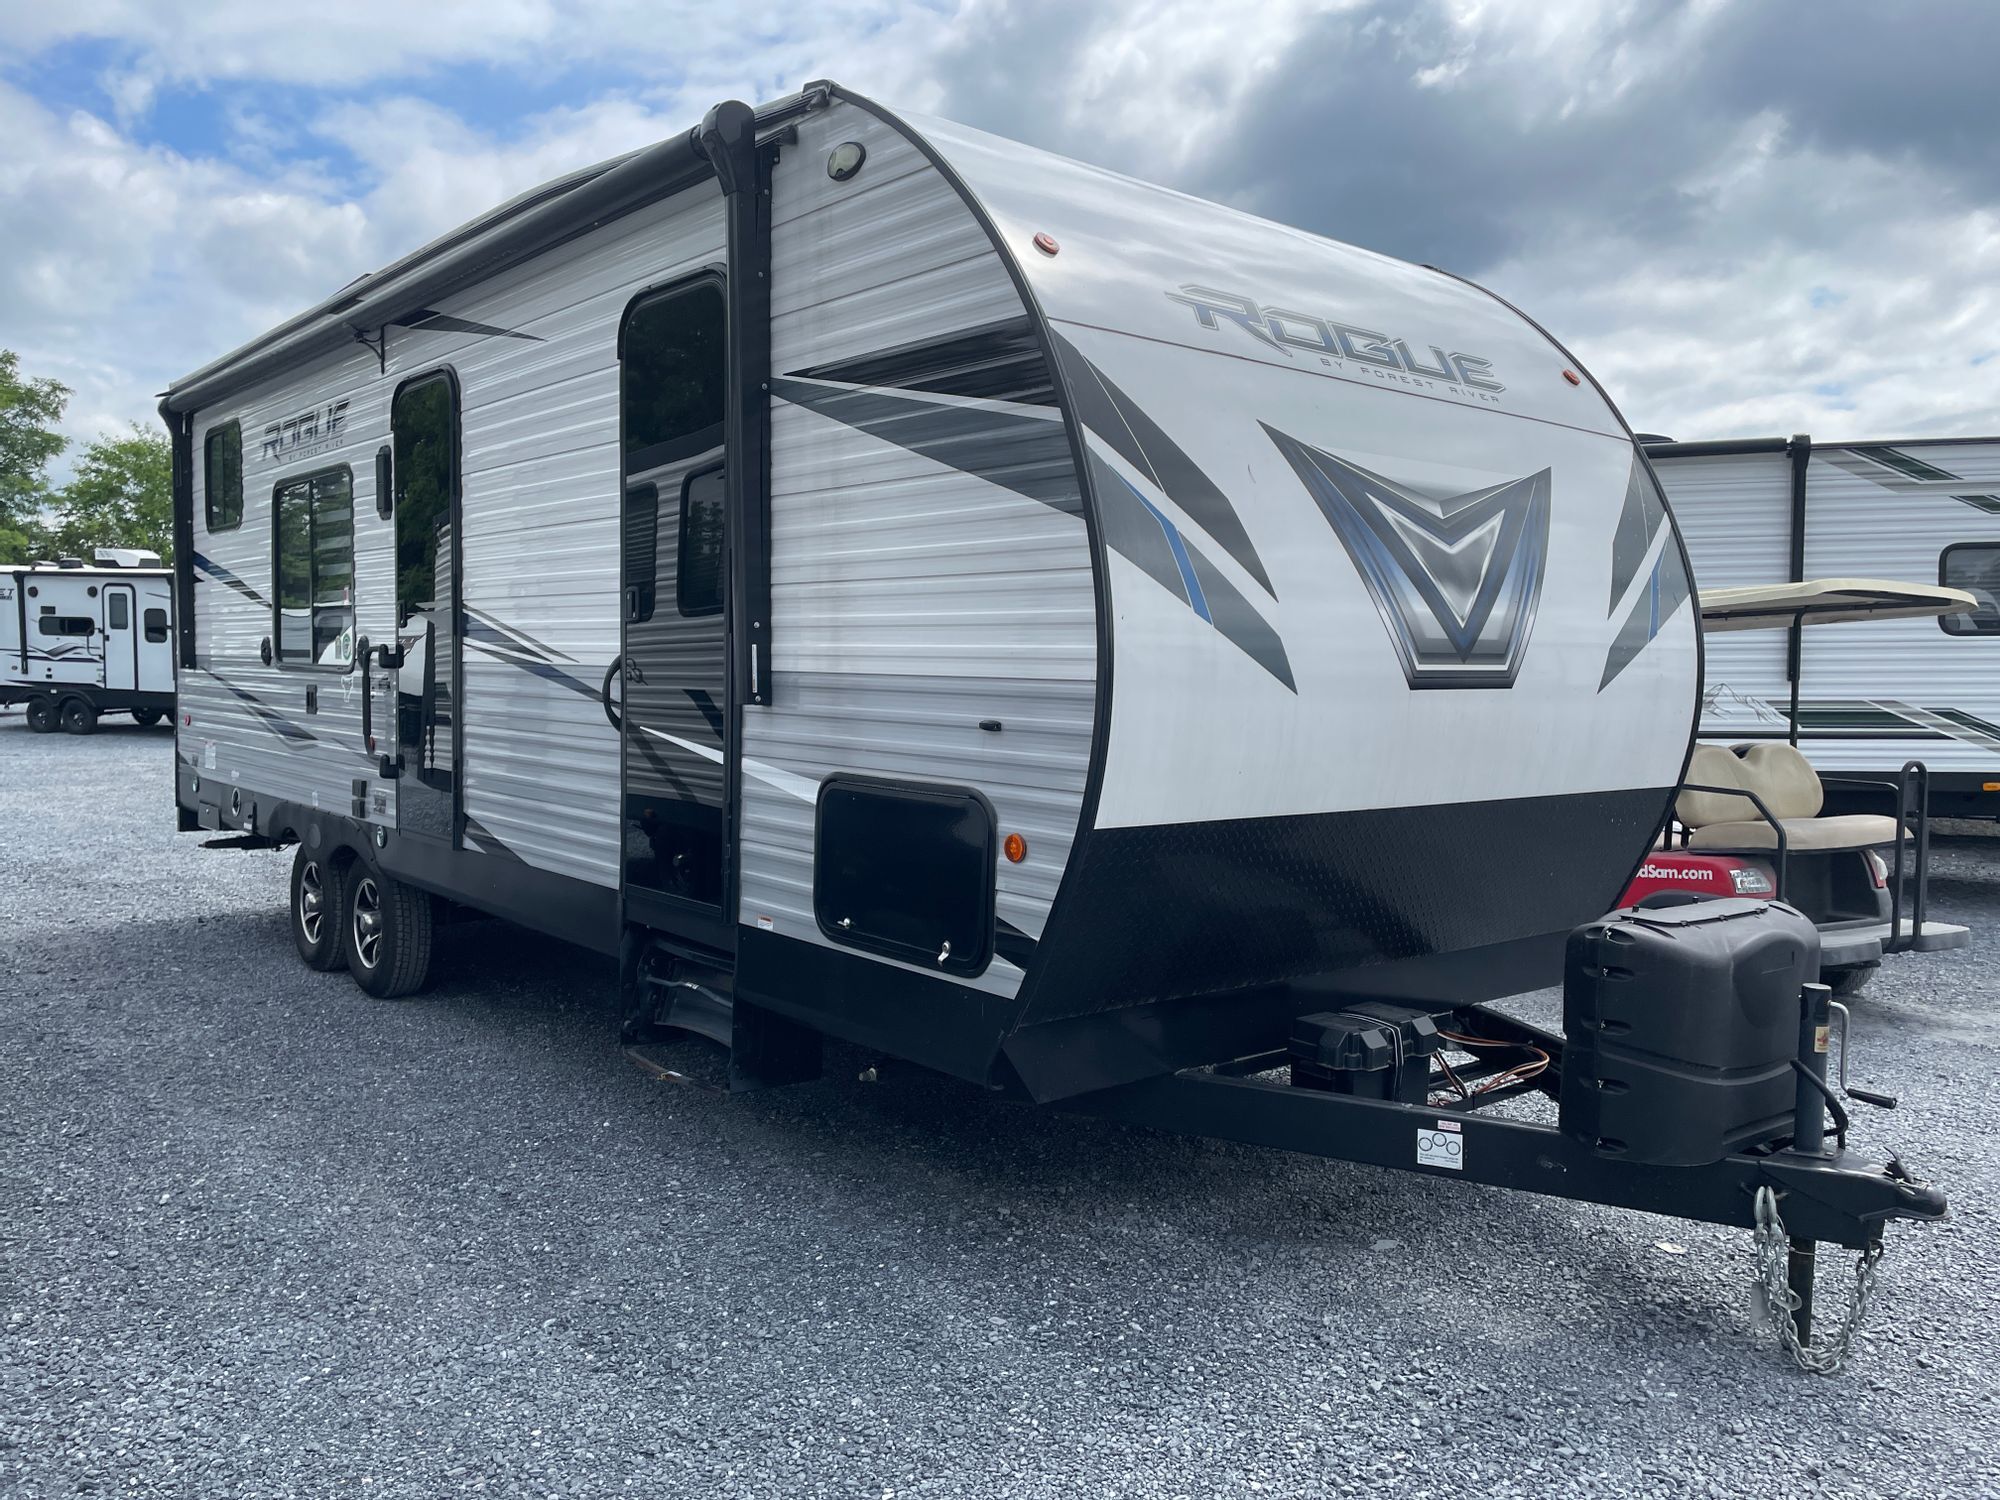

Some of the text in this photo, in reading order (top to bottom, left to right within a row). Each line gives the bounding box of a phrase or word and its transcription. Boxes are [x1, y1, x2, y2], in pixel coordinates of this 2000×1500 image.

[1164, 284, 1506, 393] ROGUE
[1320, 357, 1501, 403] BY FOREST RIVER
[261, 399, 350, 464] ROGUE
[1636, 864, 1713, 880] dSam.com
